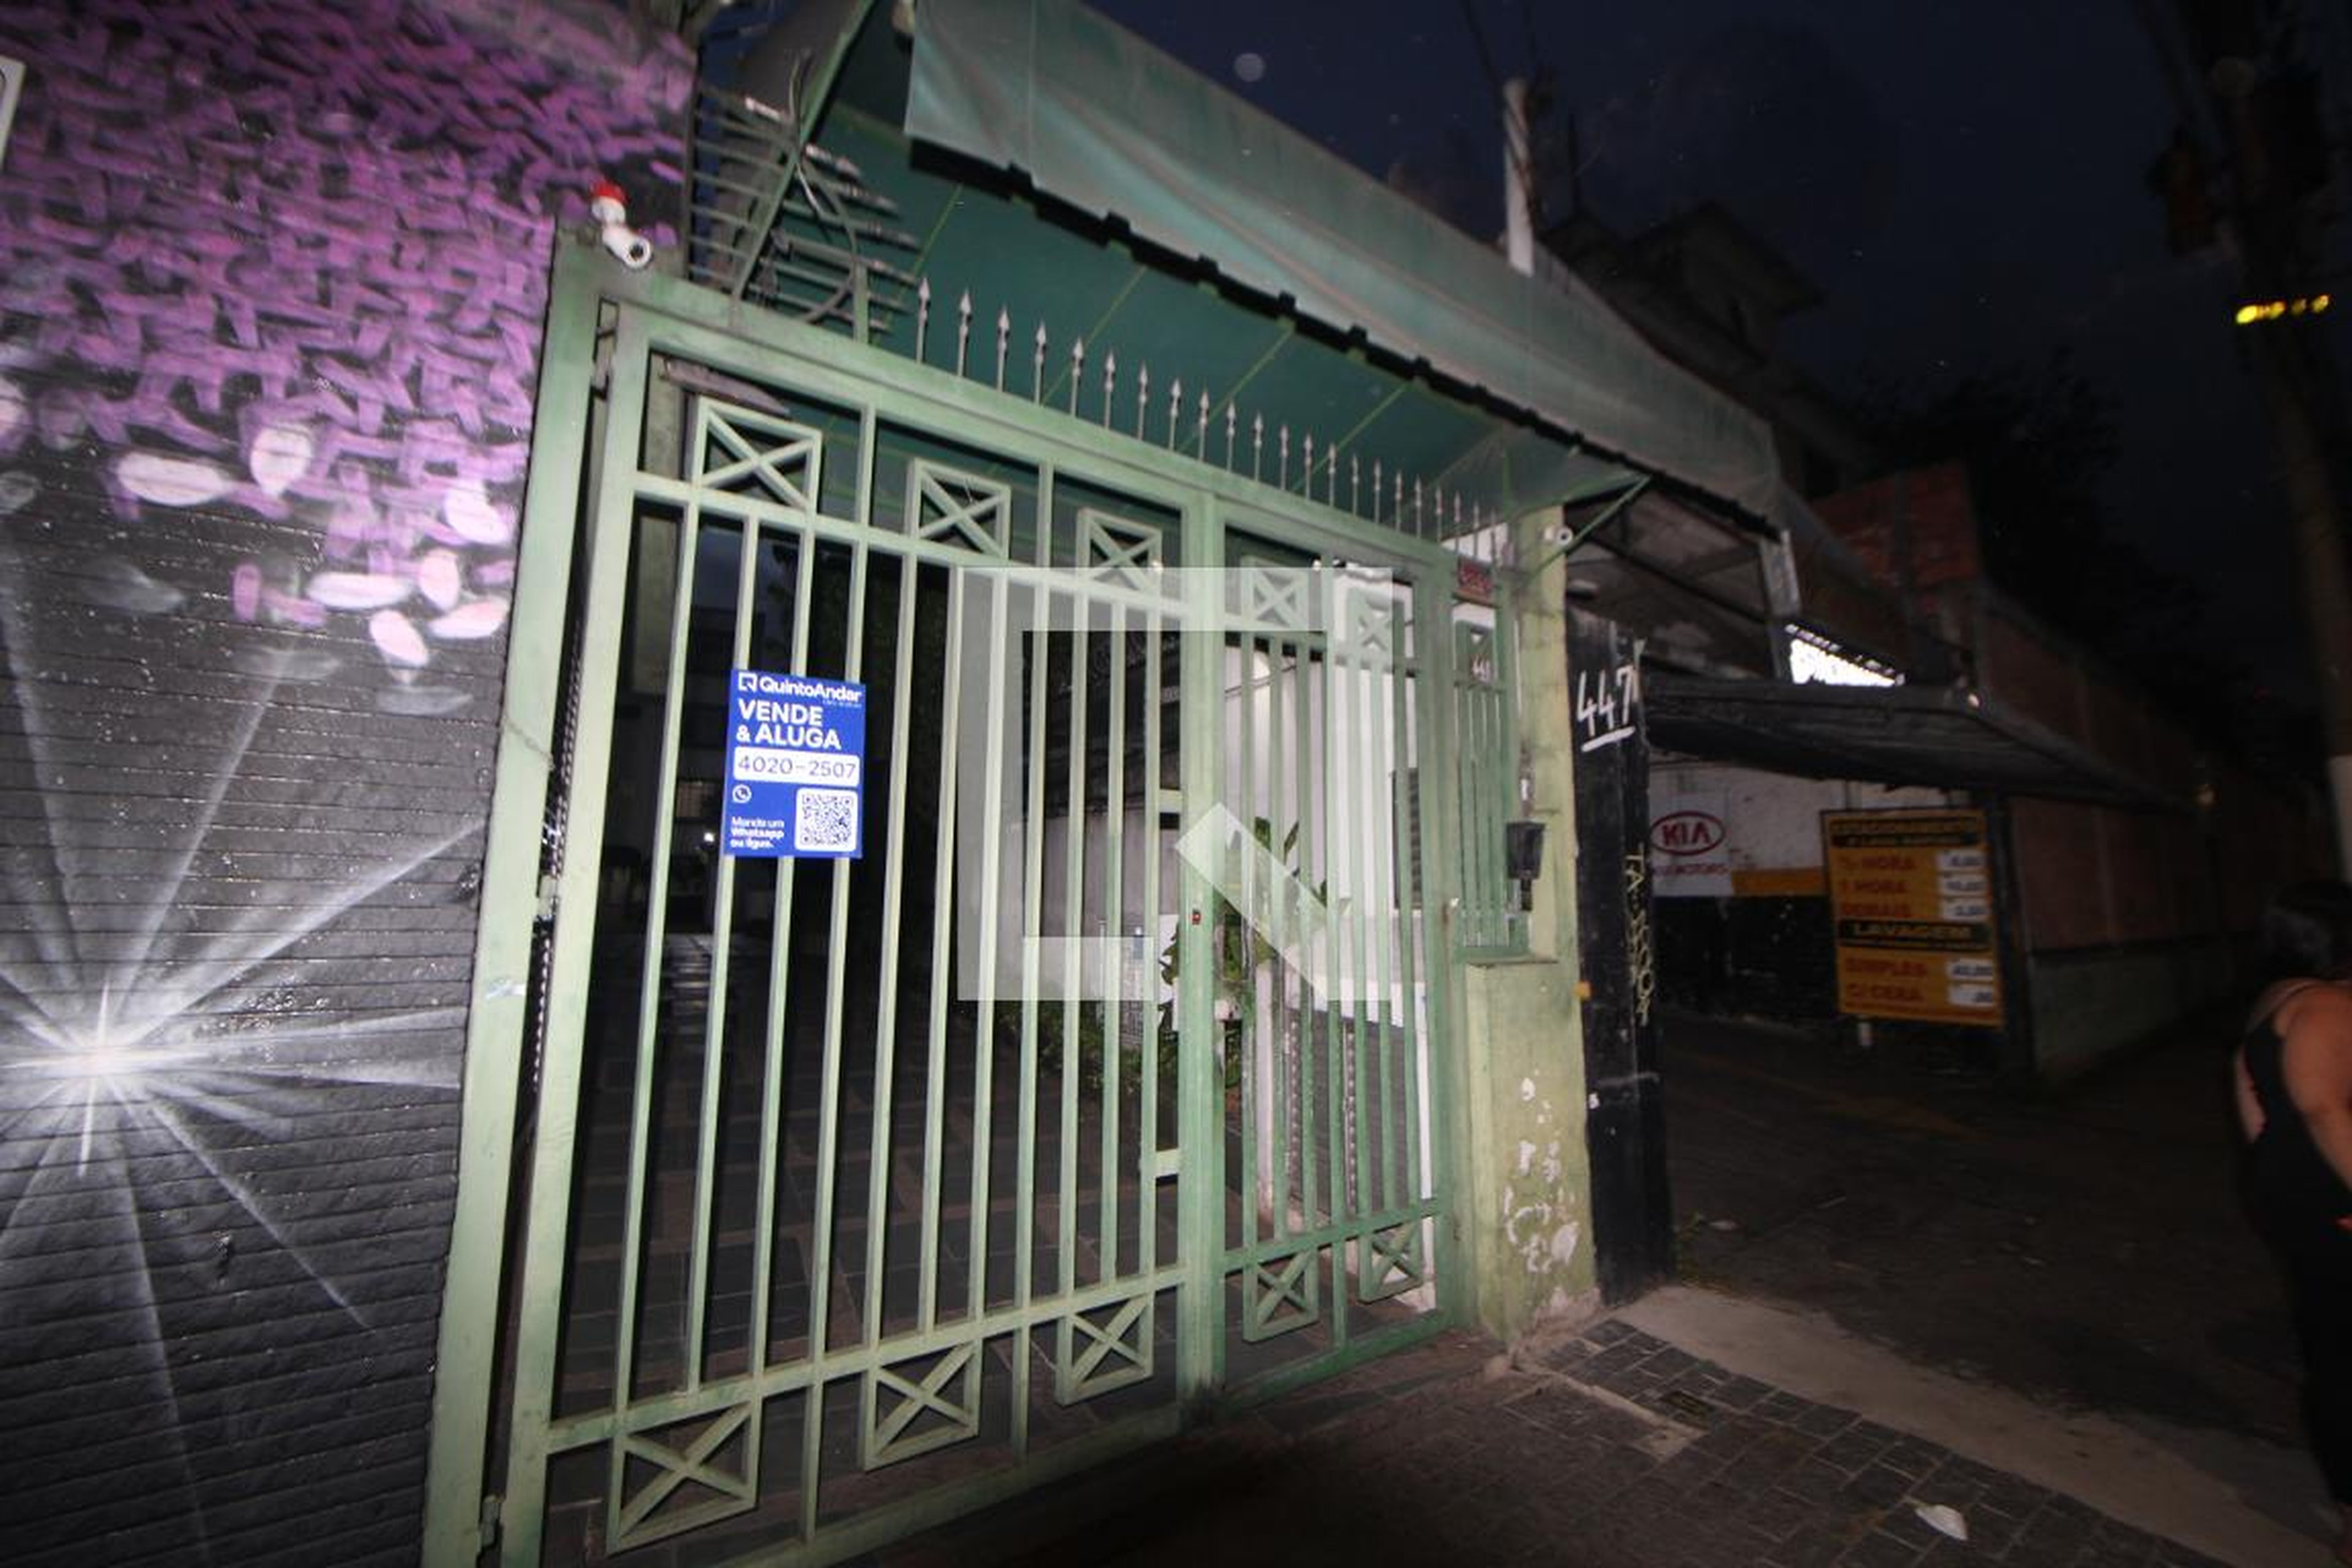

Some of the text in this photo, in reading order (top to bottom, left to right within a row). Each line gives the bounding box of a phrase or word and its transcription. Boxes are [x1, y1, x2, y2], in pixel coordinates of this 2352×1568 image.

[760, 676, 862, 702] QuintoAndar
[1577, 665, 1634, 736] 447
[738, 699, 823, 726] VENDE
[736, 723, 841, 750] & ALUGA
[738, 755, 856, 778] 4020-2507
[1662, 822, 1710, 846] KIA
[1854, 923, 1971, 940] LAVAGEM
